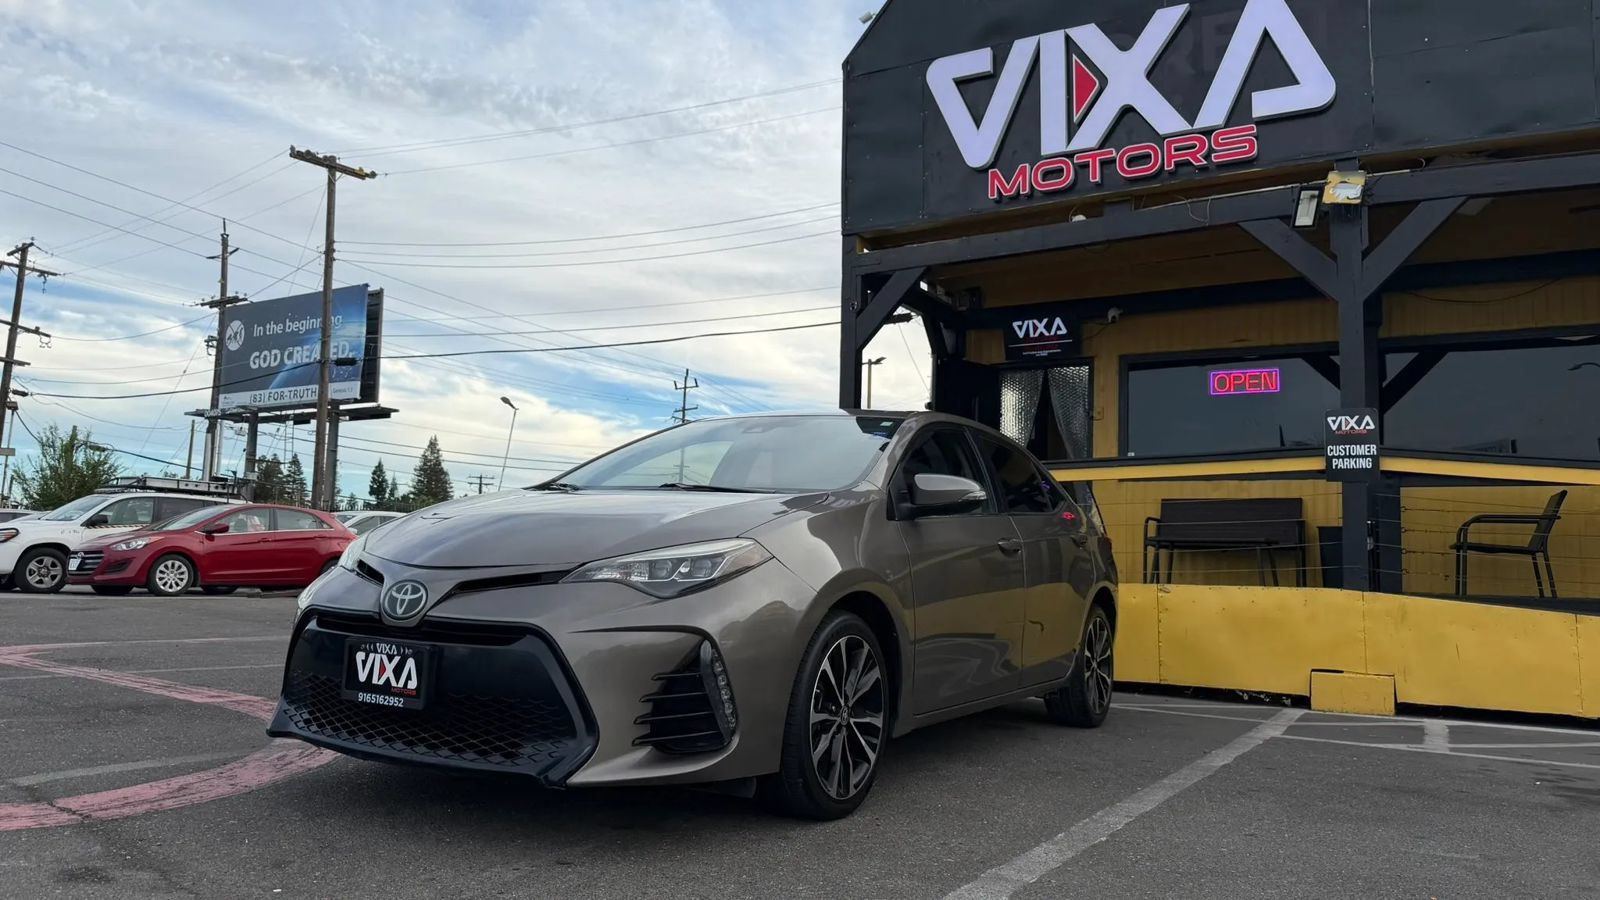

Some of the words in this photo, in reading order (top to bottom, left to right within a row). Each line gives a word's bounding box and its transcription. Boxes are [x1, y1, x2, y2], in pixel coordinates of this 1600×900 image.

[926, 0, 1337, 169] VIXA
[987, 124, 1258, 200] MOTORS
[253, 323, 264, 336] In
[266, 320, 283, 335] the
[1012, 317, 1068, 338] VIXA
[250, 349, 281, 369] GOD
[283, 340, 354, 365] CREAED.
[1214, 371, 1277, 392] OPEN
[249, 393, 266, 405] (83)
[267, 387, 318, 402] FOR-TRUTH
[1327, 415, 1376, 431] VIXA
[1327, 444, 1378, 457] CUSTOMER
[1332, 457, 1373, 470] PARKING
[376, 643, 398, 654] VIXA
[356, 651, 418, 689] VIXA
[358, 693, 404, 707] 9165162952
